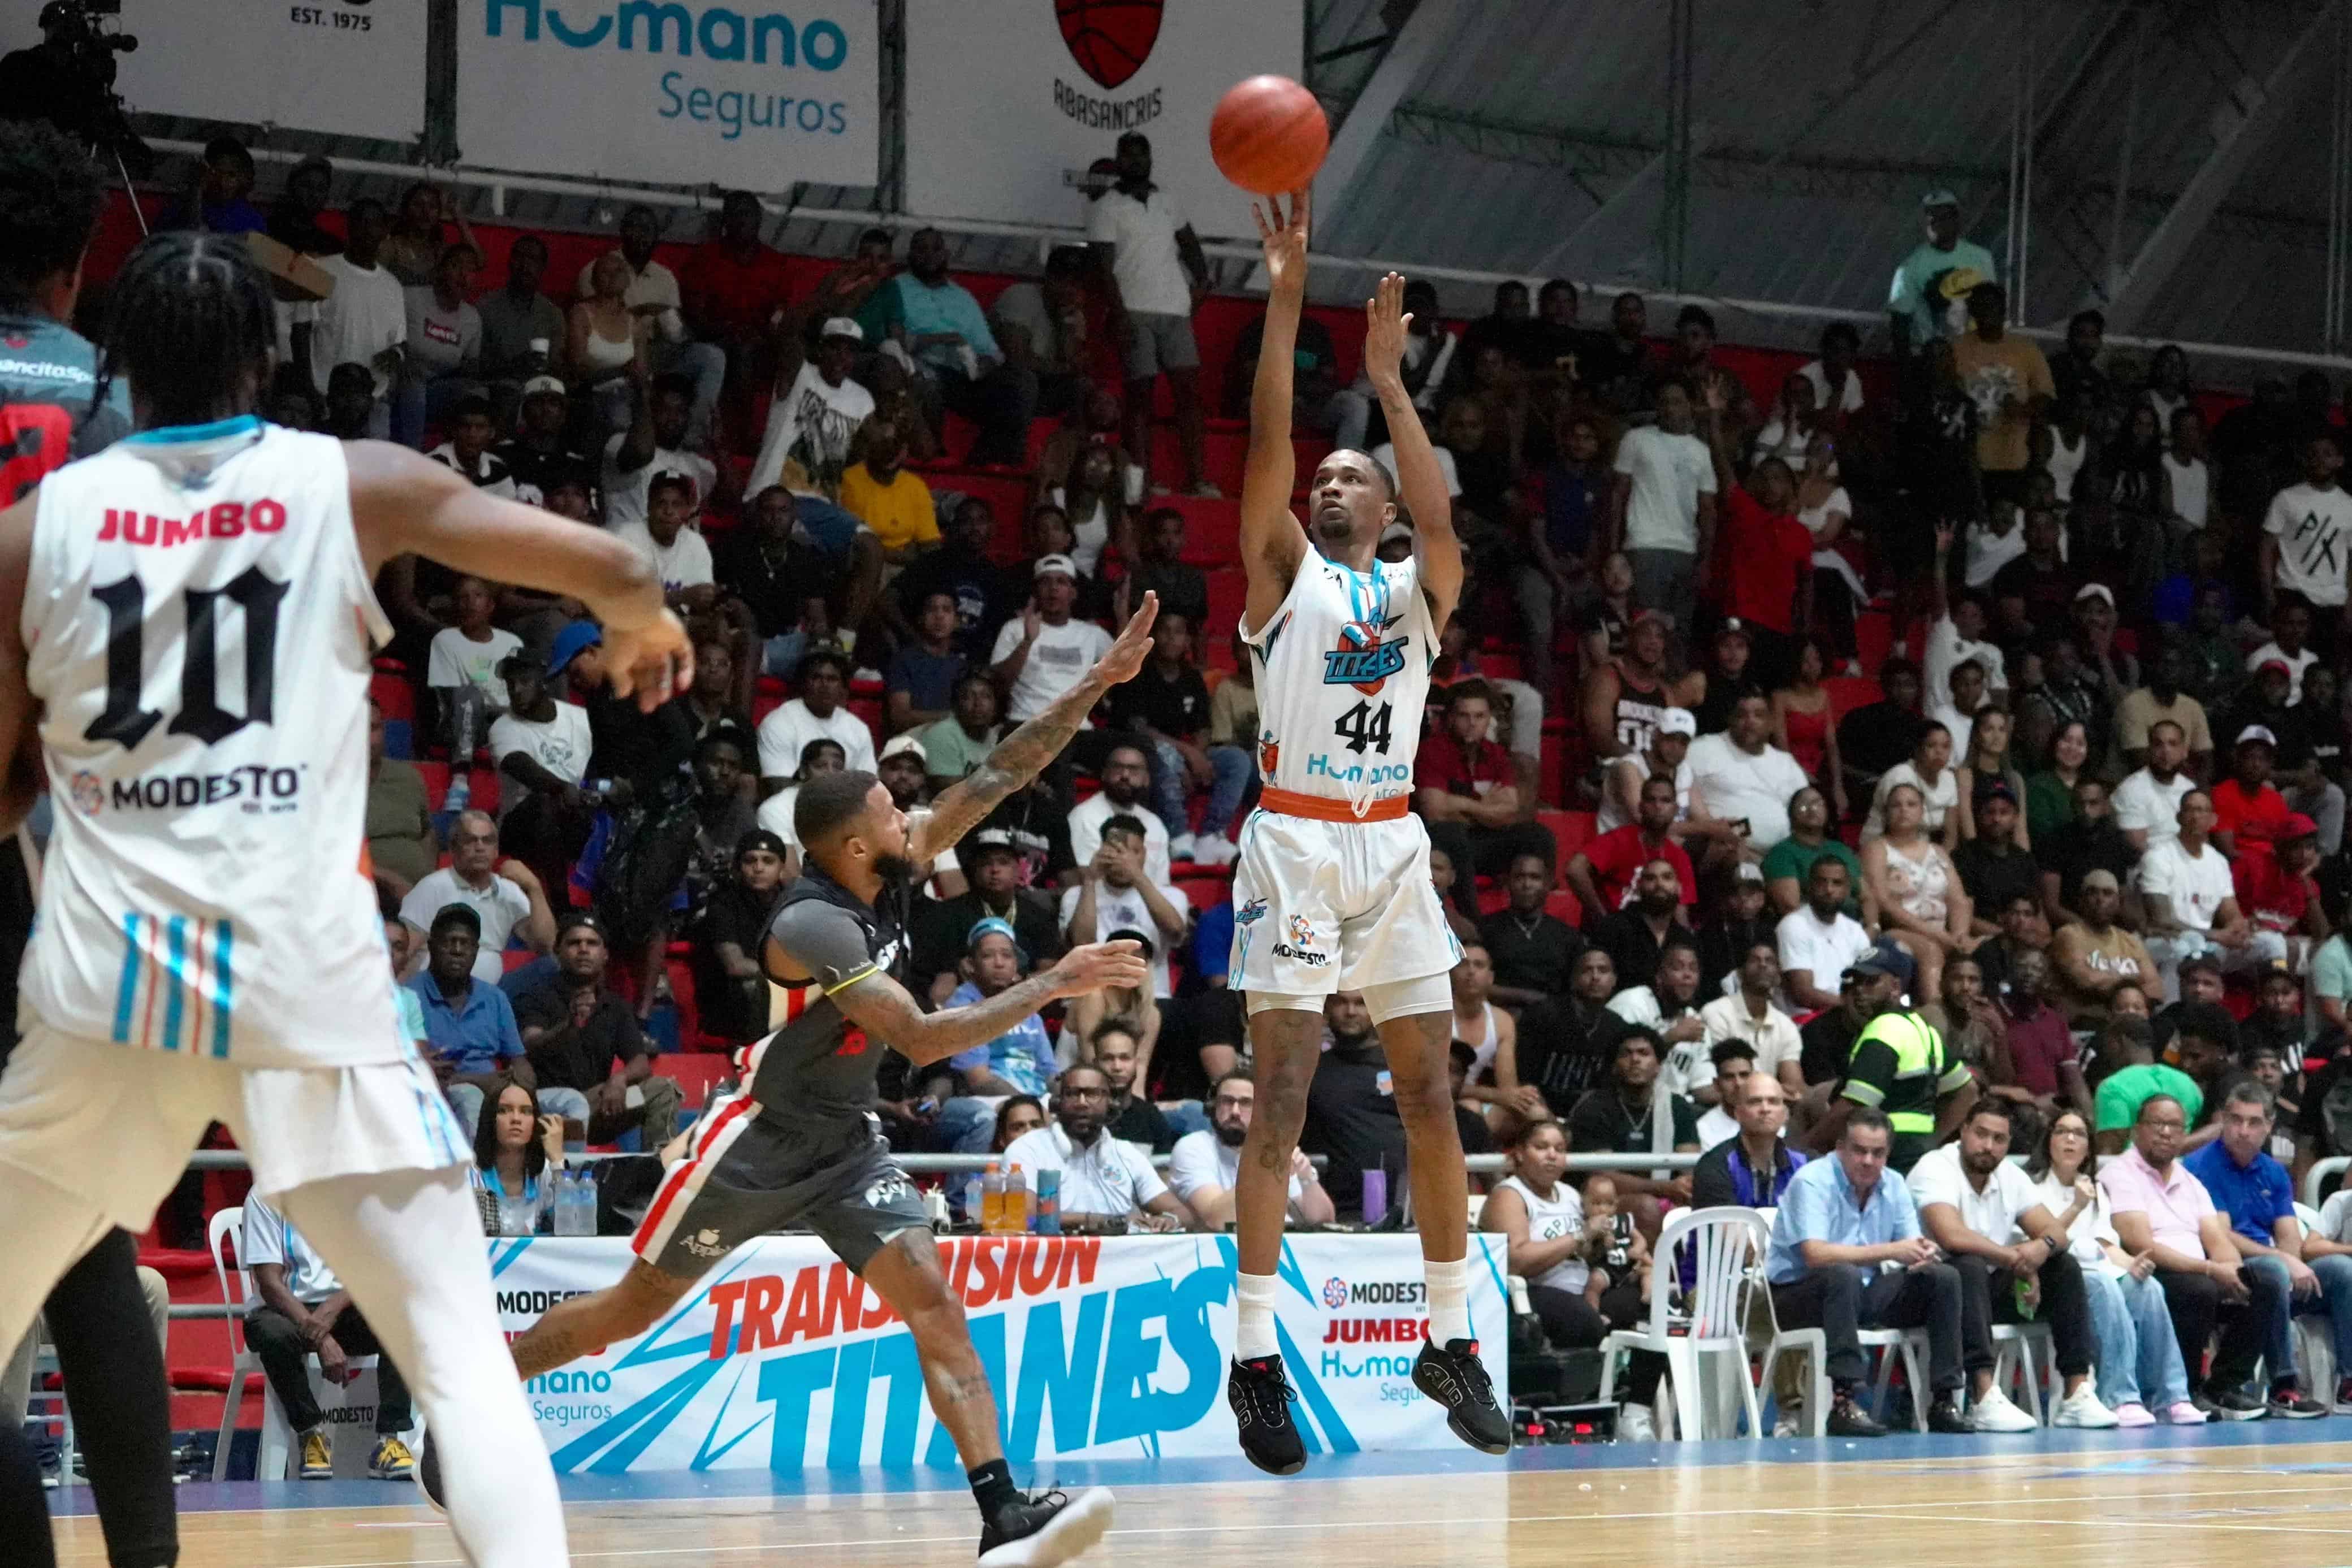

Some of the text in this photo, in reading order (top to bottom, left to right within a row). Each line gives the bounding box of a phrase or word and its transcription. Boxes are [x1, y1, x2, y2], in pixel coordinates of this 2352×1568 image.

[291, 6, 371, 32] EST. 1975
[658, 71, 847, 140] Seguros
[1054, 77, 1162, 131] ABASANCRIS
[97, 498, 287, 548] JUMBO
[83, 564, 292, 752] 10
[1334, 697, 1393, 756] 44
[113, 765, 298, 809] MODESTO
[1351, 1282, 1427, 1304] MODEST
[322, 1406, 374, 1424] MODESTO
[533, 1400, 612, 1427] Seguros
